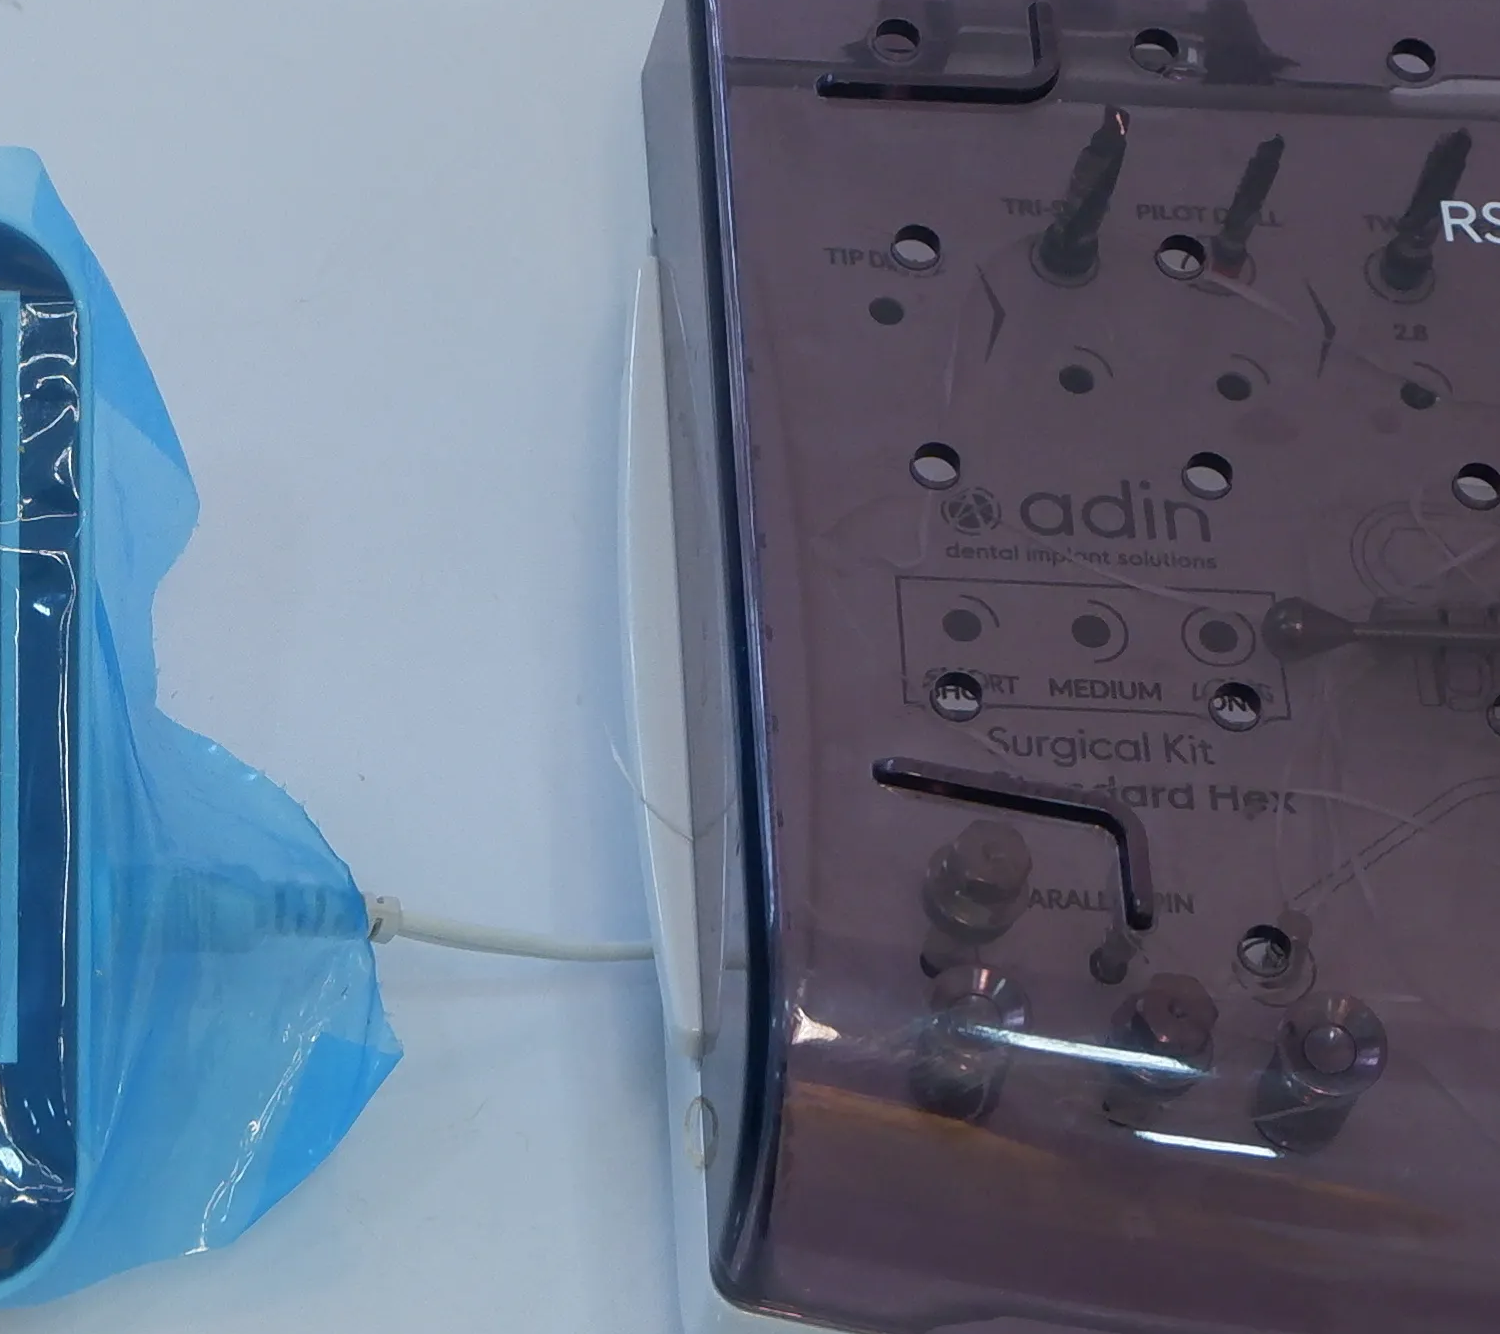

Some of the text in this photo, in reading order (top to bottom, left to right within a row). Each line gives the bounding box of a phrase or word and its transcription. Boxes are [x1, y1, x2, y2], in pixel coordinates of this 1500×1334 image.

[1135, 203, 1204, 223] PILOT
[824, 246, 864, 266] TIP
[1019, 479, 1212, 543] adin
[944, 541, 1019, 562] dental
[1116, 546, 1218, 571] solutions
[1047, 676, 1163, 702] MEDIUM
[986, 725, 1216, 769] Surgical Kit
[1208, 783, 1299, 815] Hex
